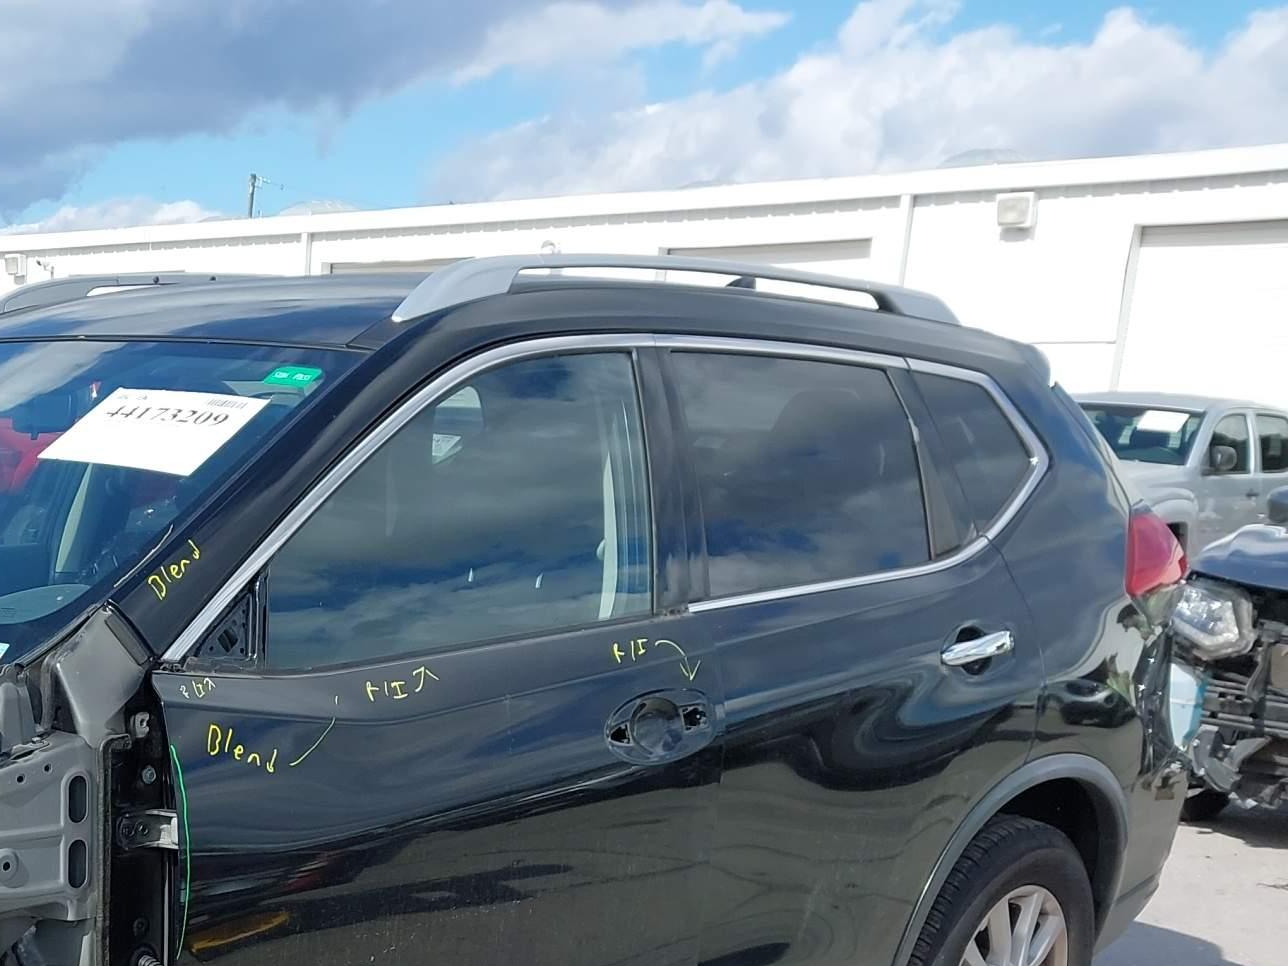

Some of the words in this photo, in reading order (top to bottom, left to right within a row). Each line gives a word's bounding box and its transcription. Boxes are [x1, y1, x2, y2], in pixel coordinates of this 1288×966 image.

[106, 404, 230, 427] 44173209
[147, 538, 202, 601] Blend
[207, 724, 278, 773] Blend
